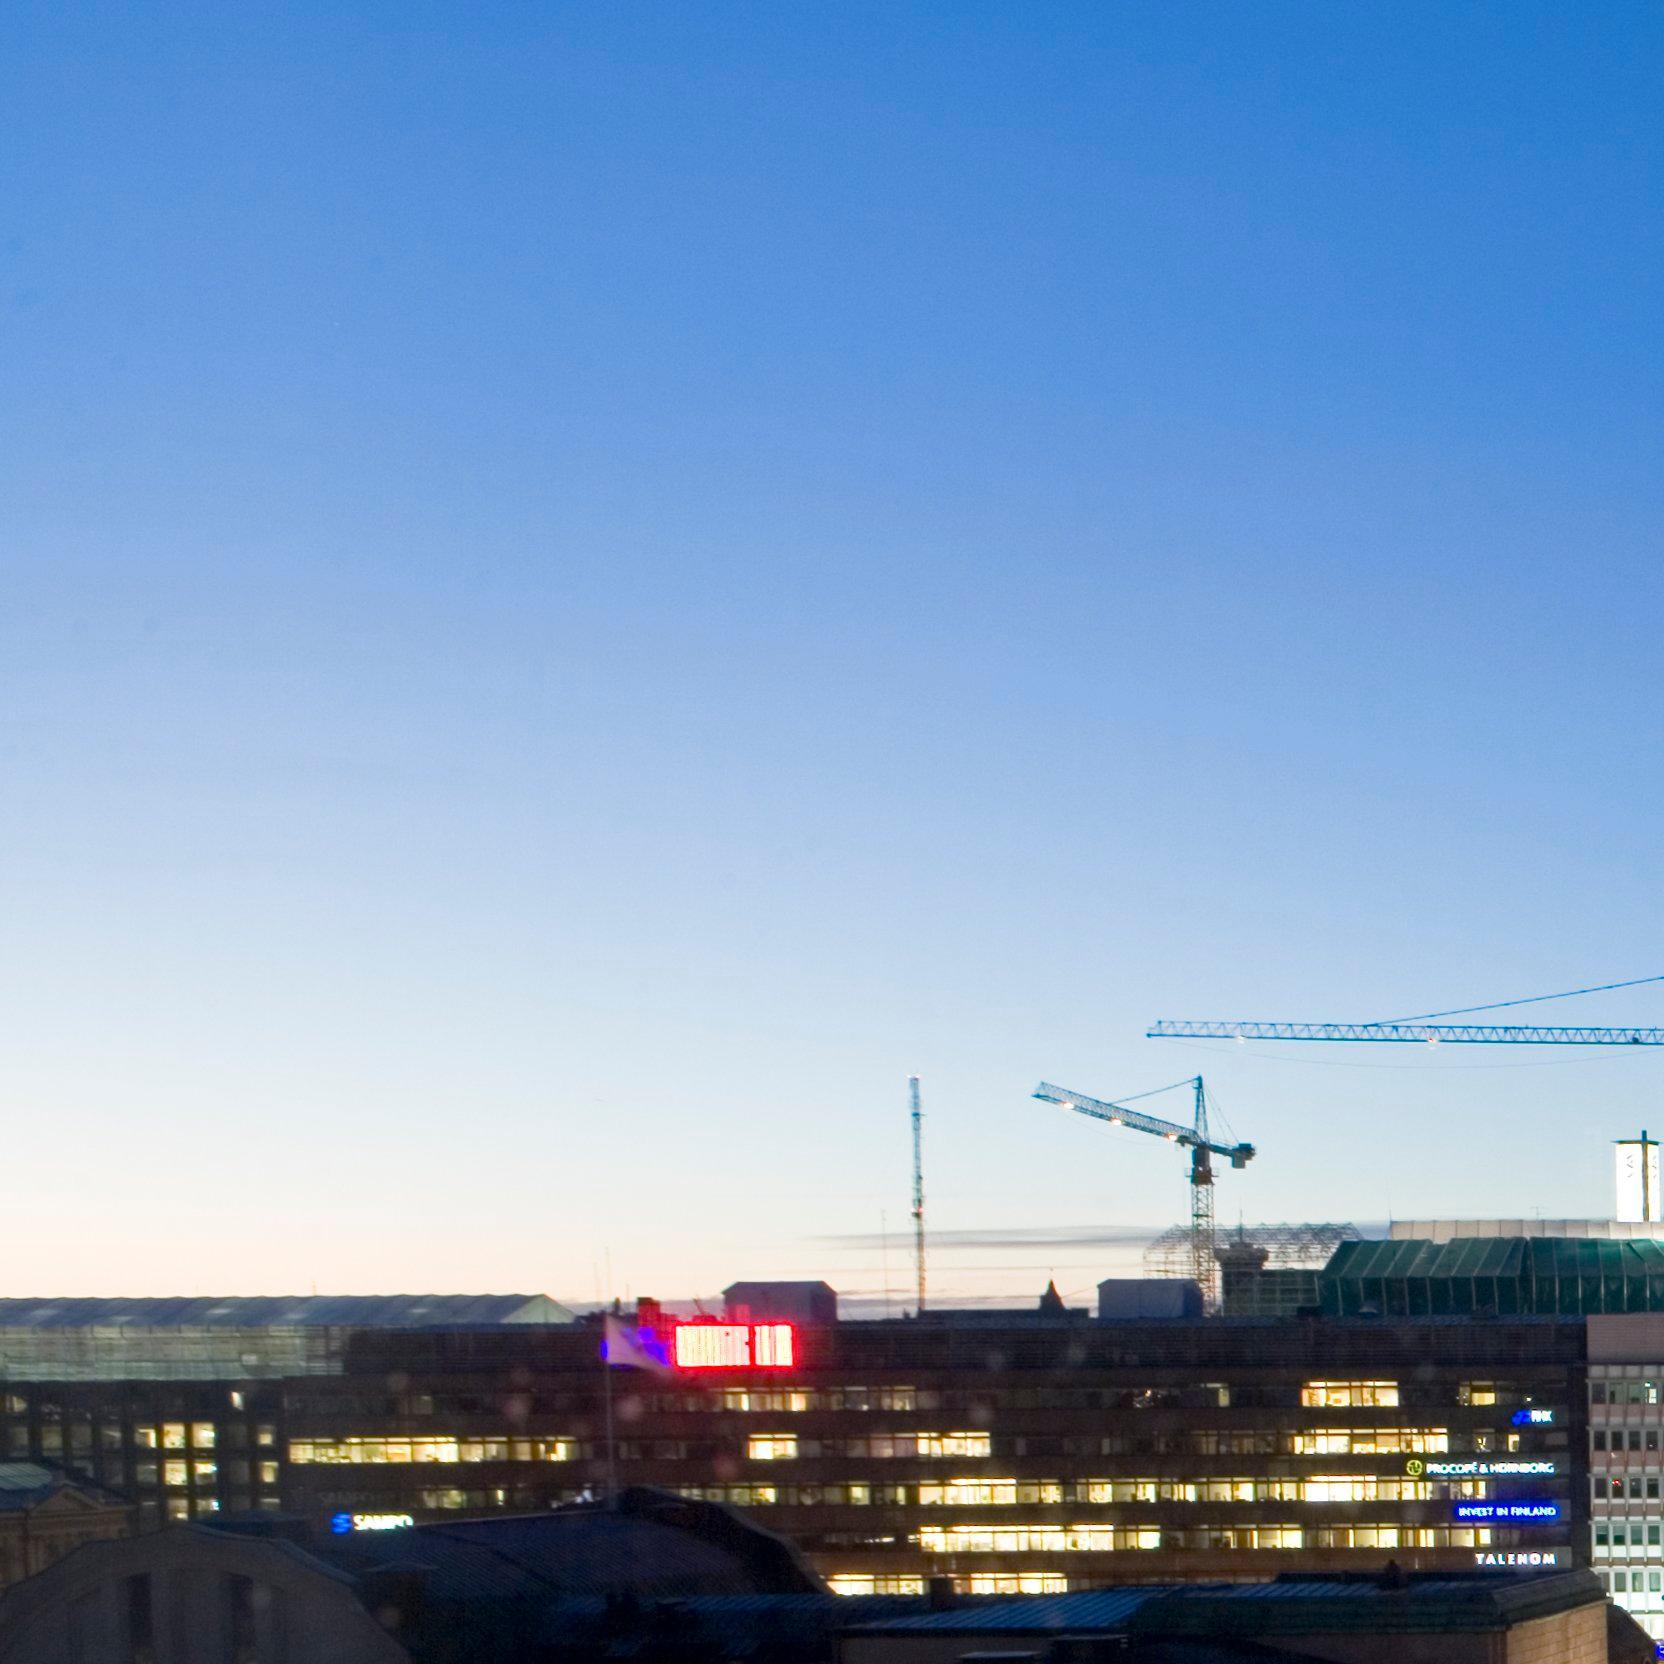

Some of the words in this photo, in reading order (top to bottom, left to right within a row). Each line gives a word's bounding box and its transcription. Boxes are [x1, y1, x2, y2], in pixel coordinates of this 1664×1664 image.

[1479, 1463, 1489, 1474] &
[1497, 1506, 1508, 1517] IN
[1511, 1506, 1556, 1517] FINLAND
[1475, 1553, 1556, 1565] TALENOM
